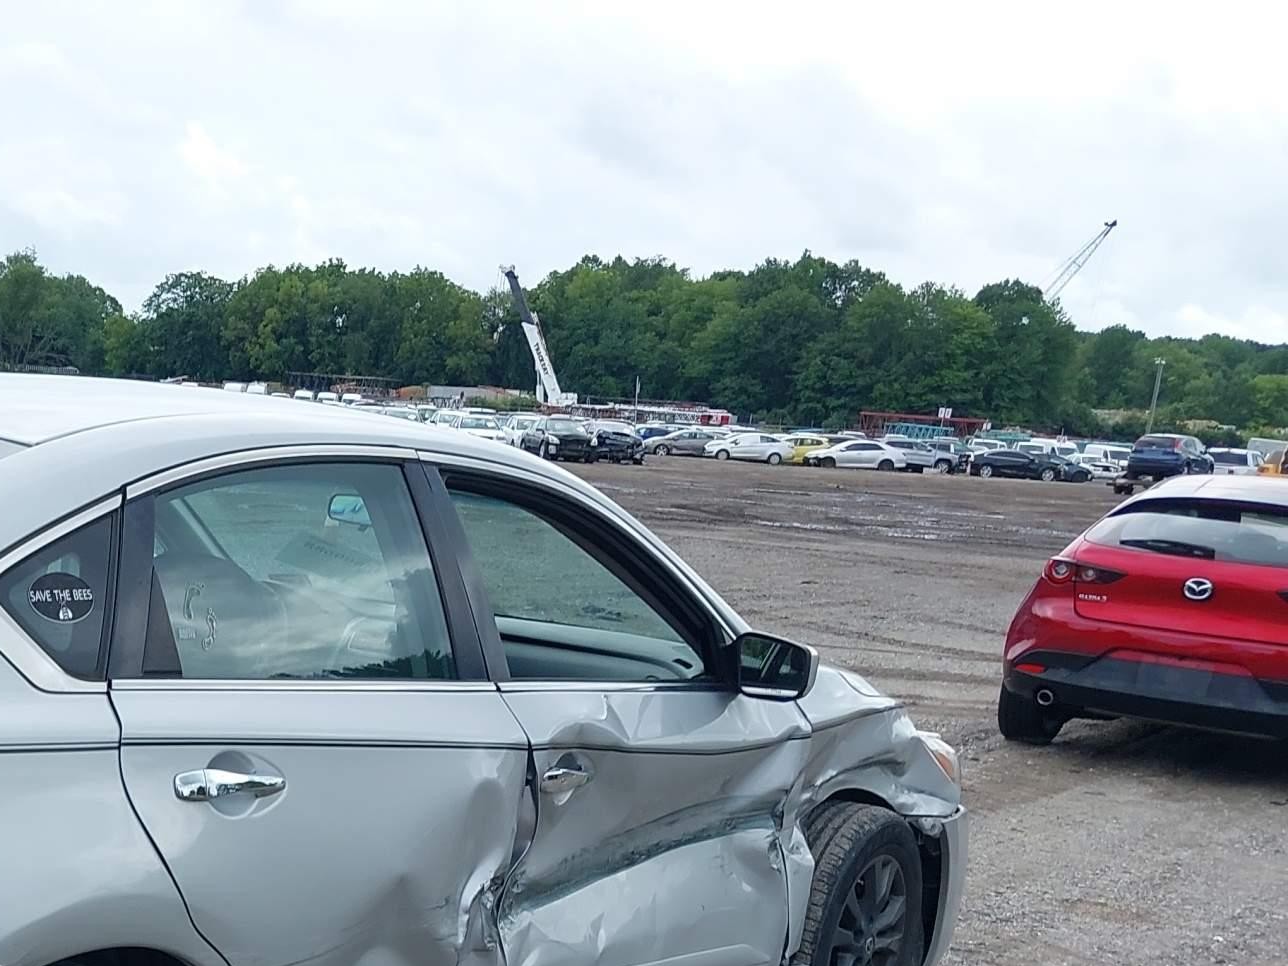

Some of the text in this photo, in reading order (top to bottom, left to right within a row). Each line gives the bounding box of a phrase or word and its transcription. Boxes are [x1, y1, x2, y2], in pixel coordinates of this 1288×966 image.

[30, 589, 92, 602] SAVE THE BEES
